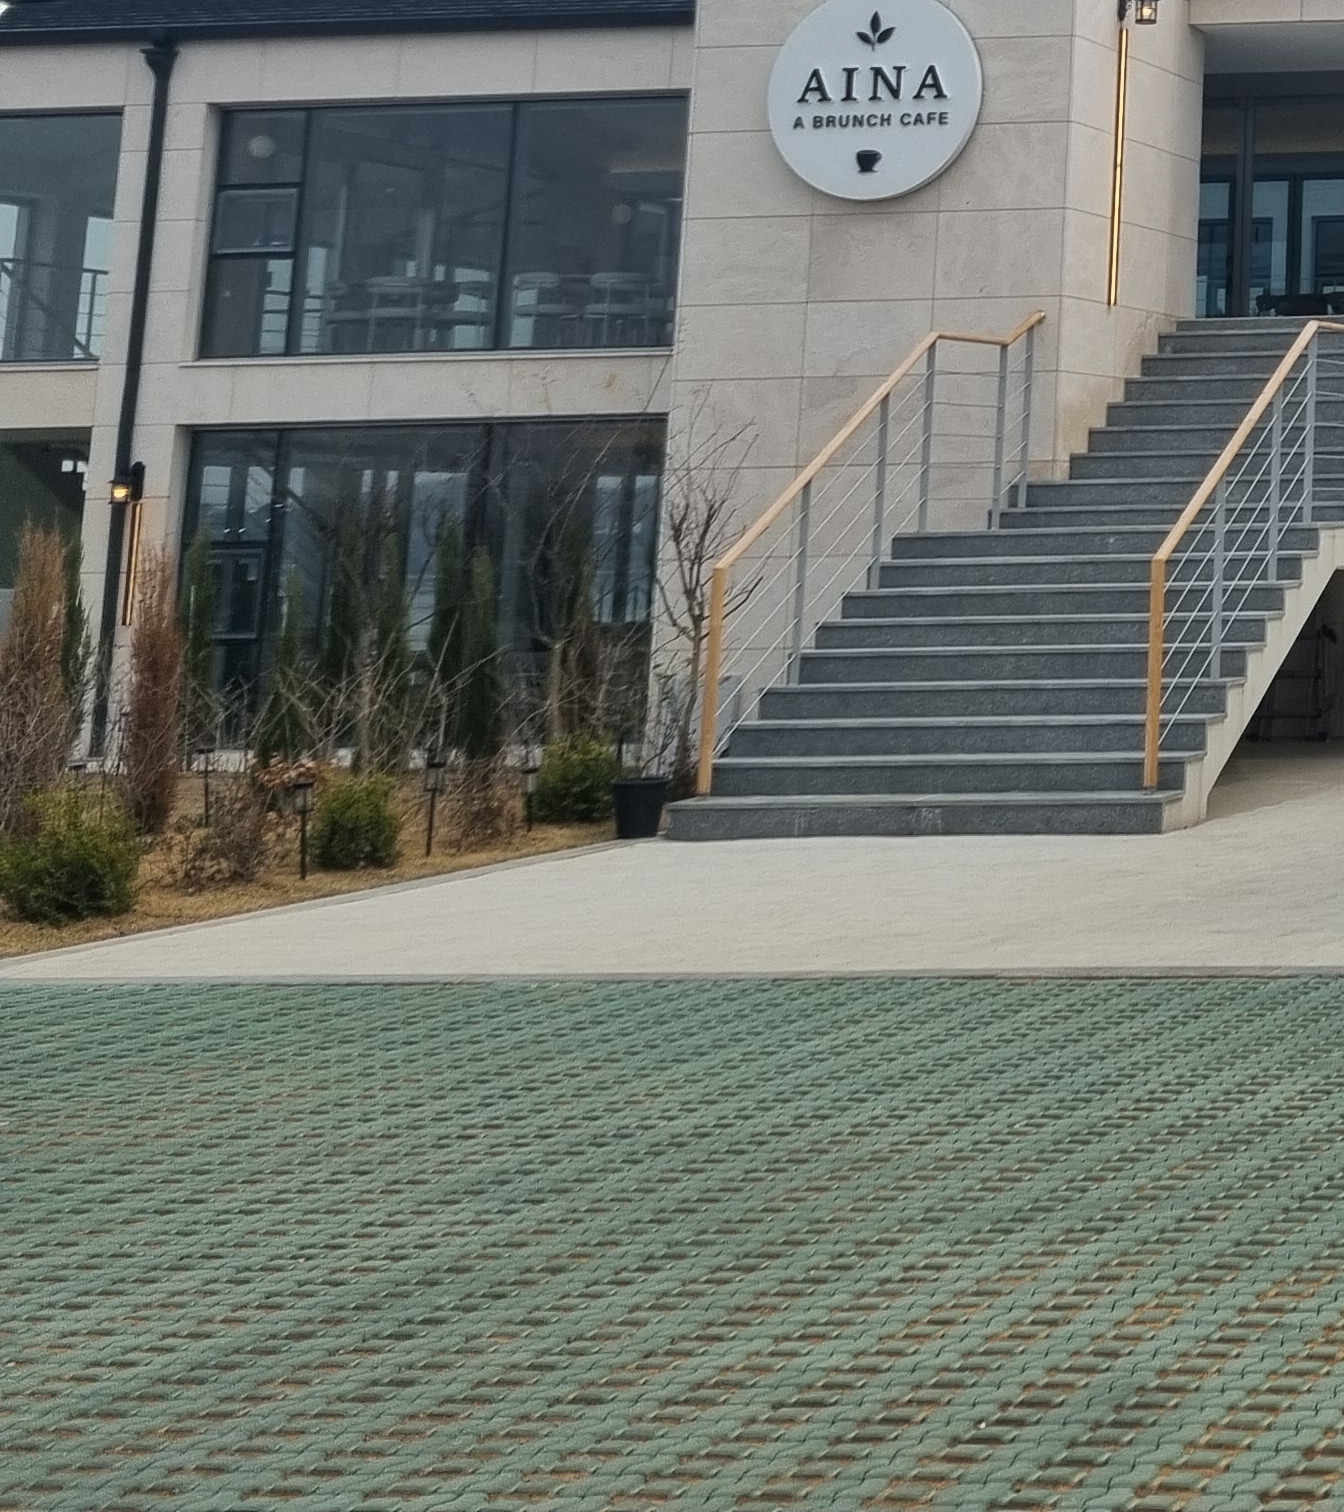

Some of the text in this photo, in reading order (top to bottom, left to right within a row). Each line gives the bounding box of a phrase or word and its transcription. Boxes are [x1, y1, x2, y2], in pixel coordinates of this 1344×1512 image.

[797, 64, 949, 104] AINA
[792, 111, 949, 130] A BRUNCH CAFE
